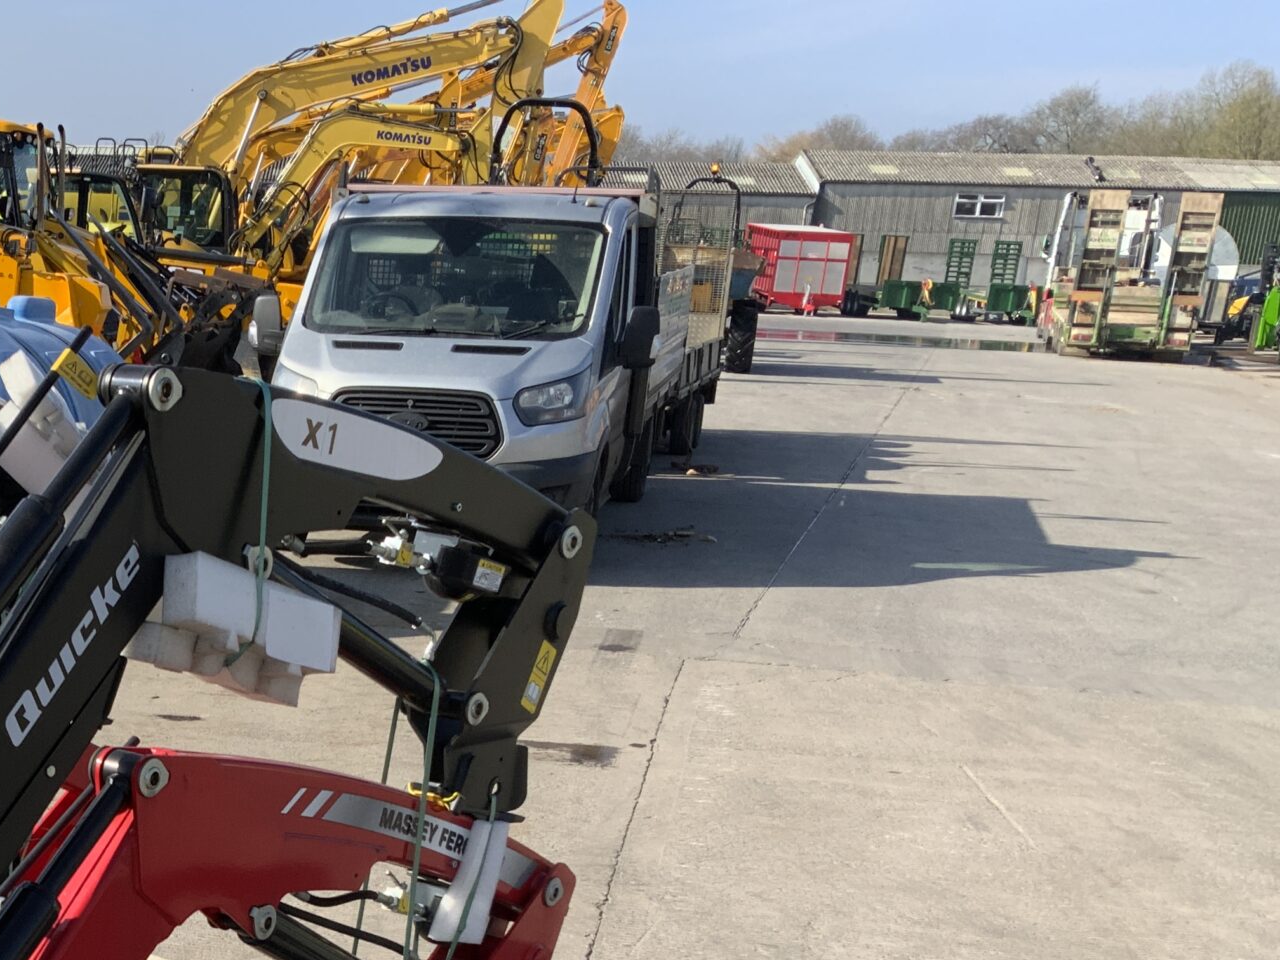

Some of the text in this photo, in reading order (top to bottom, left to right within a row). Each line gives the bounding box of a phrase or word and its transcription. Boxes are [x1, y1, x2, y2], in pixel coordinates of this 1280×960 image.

[351, 56, 432, 87] KOMATSU
[376, 130, 432, 146] KOMATSU
[5, 540, 141, 748] Quicke
